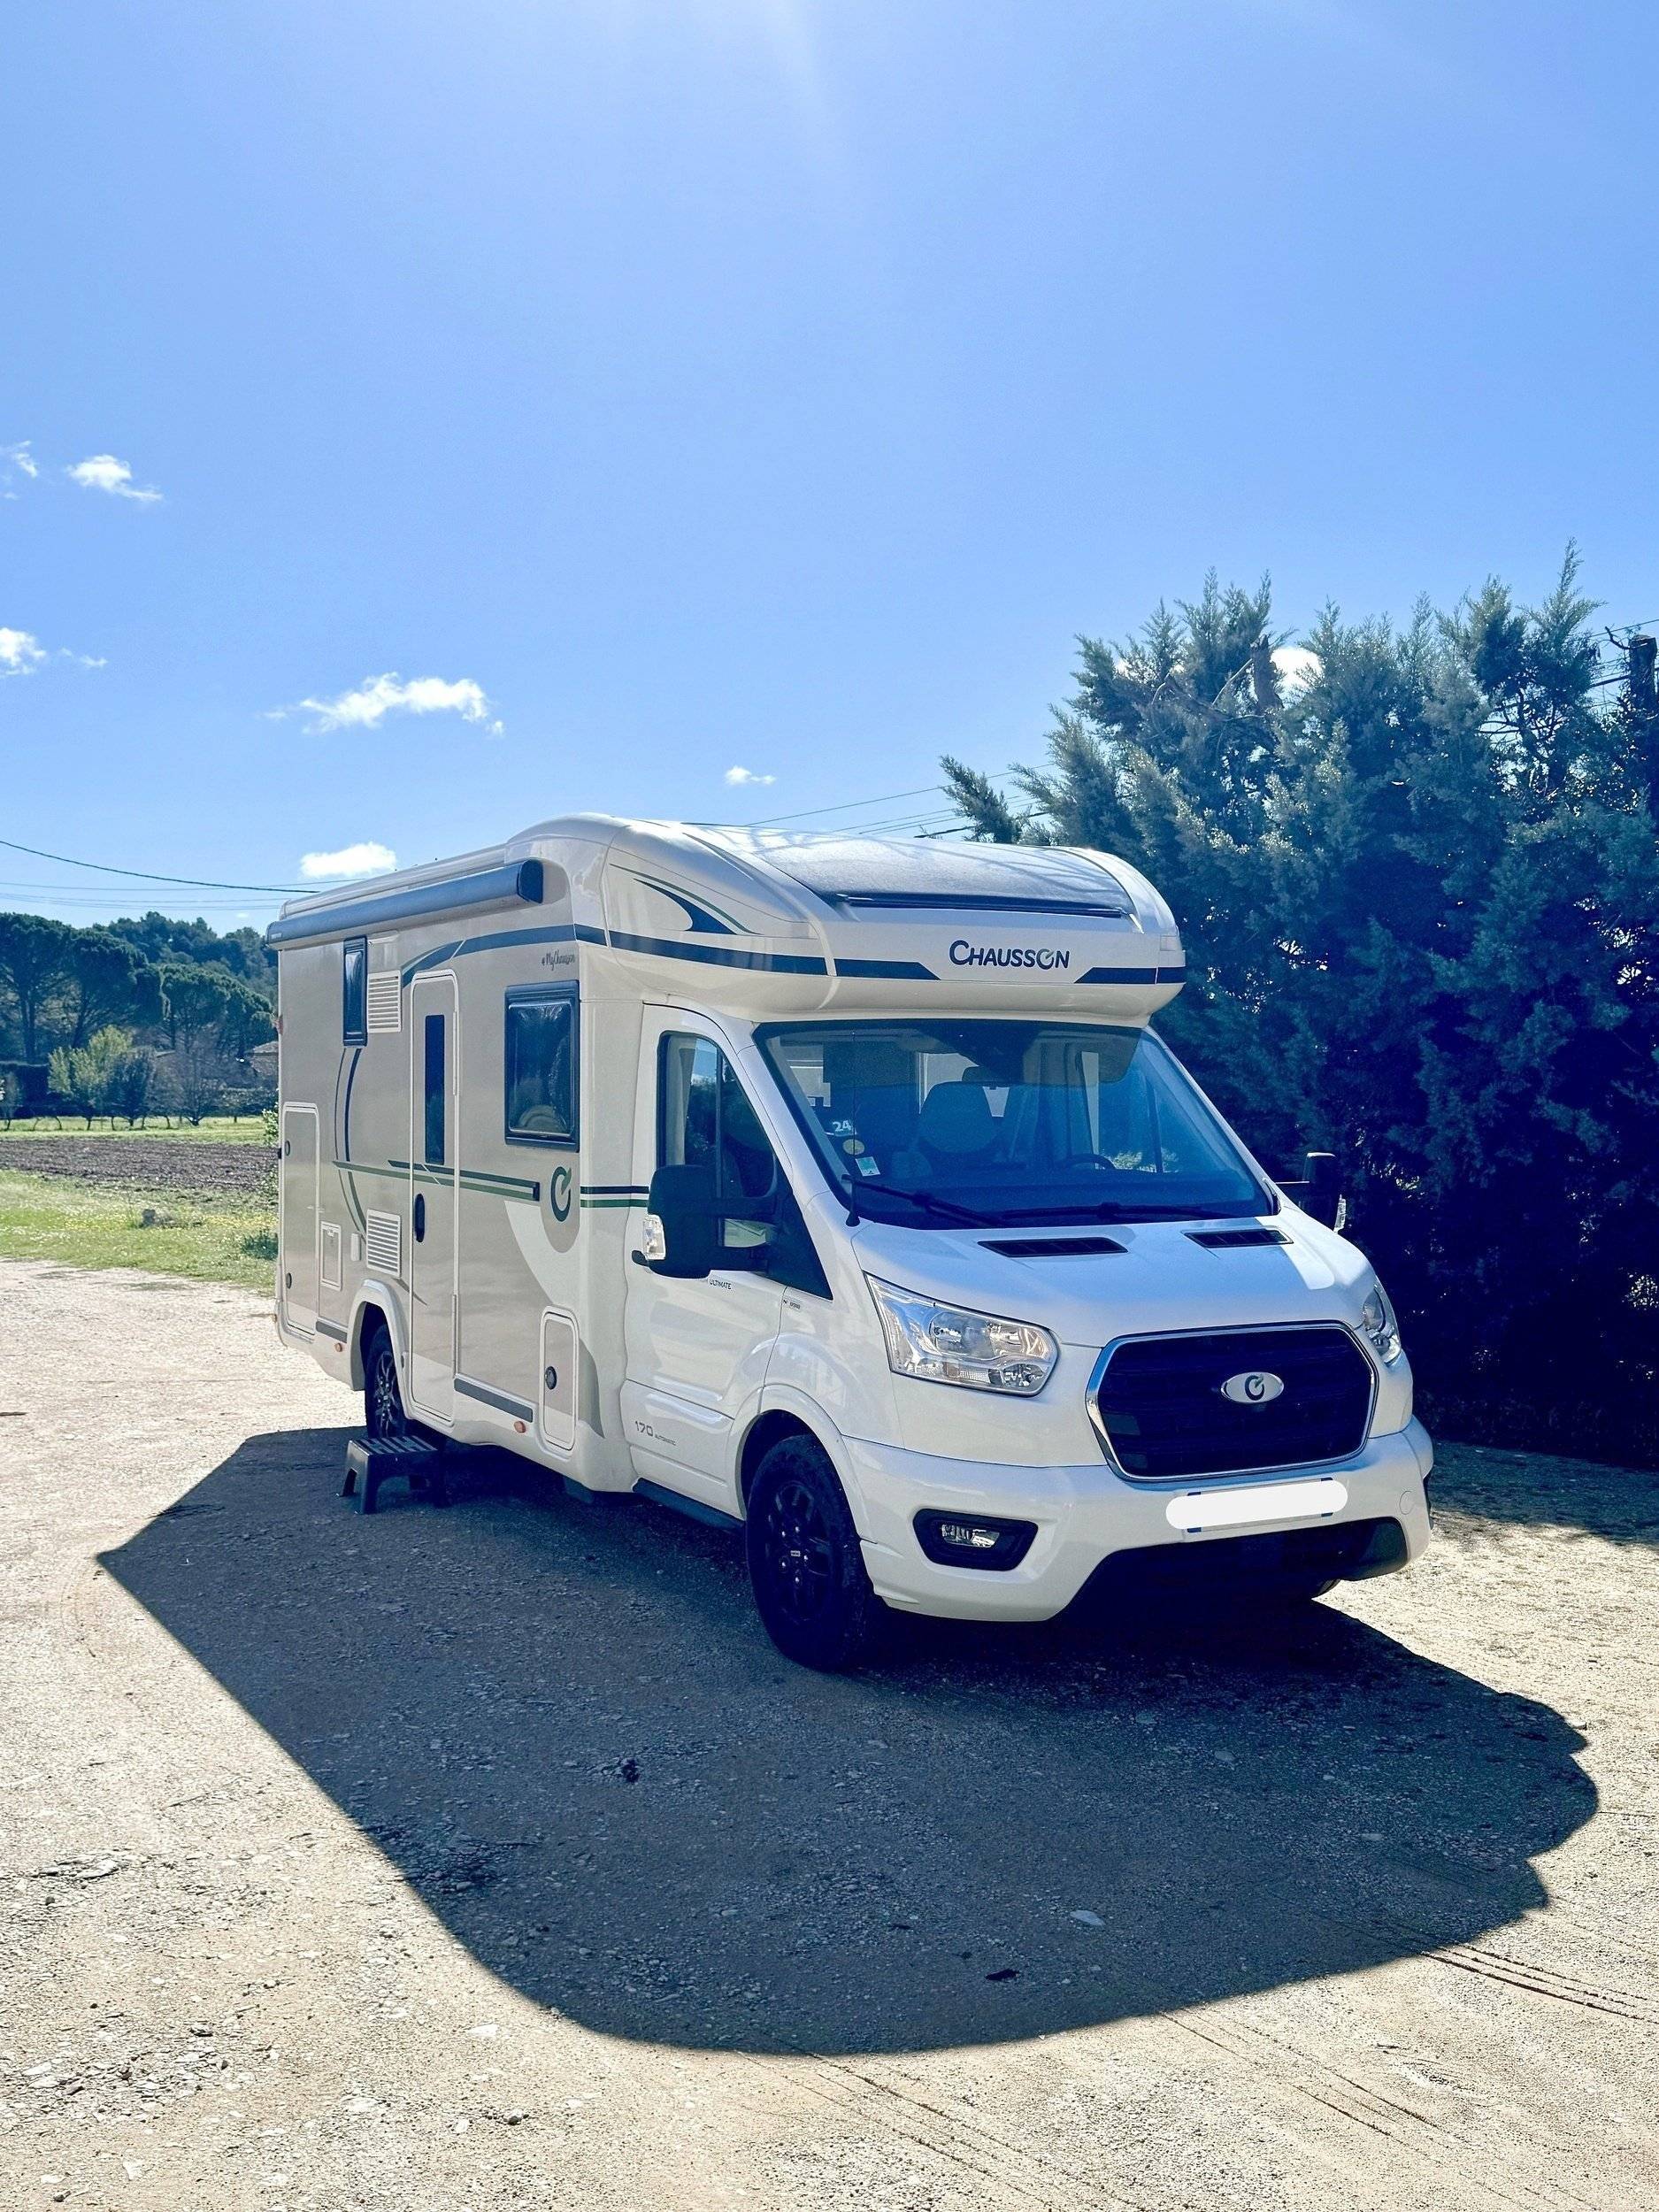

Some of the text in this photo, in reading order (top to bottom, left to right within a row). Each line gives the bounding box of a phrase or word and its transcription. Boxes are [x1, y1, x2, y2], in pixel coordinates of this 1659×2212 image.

[949, 940, 1070, 970] CHAUSSON
[833, 1120, 852, 1132] 24
[709, 1279, 732, 1290] ULTIMATE
[635, 1420, 654, 1437] 170
